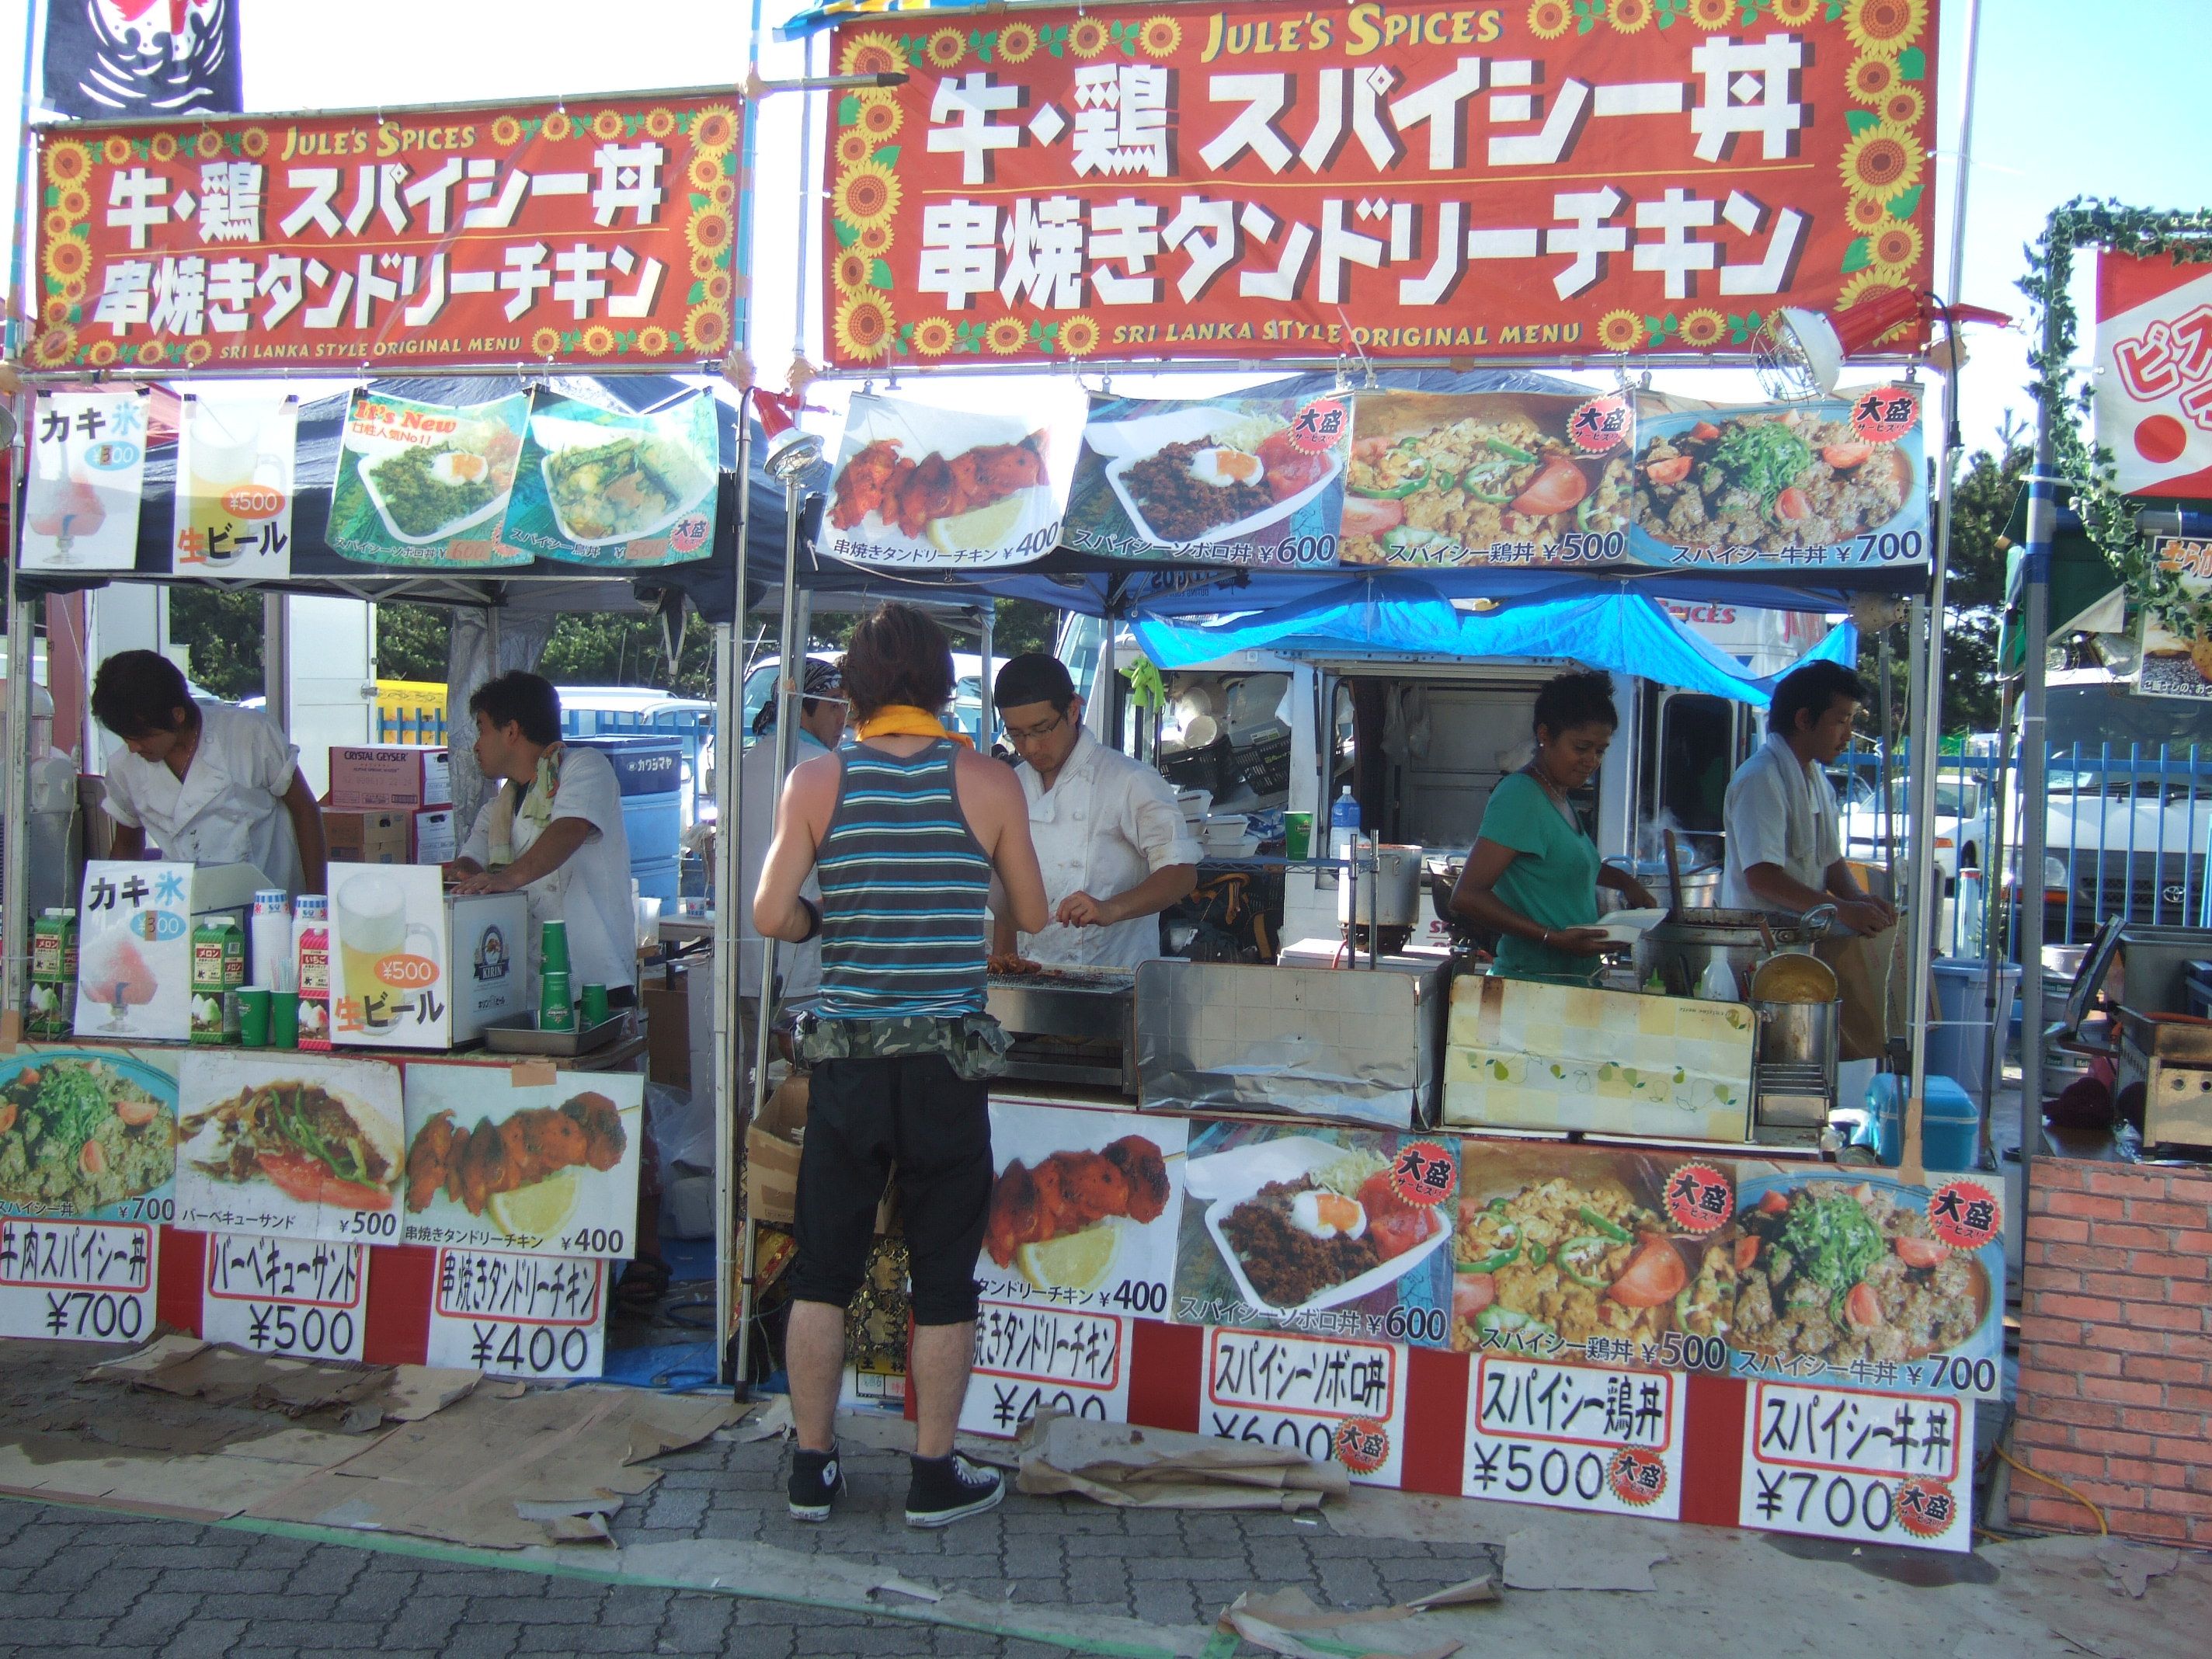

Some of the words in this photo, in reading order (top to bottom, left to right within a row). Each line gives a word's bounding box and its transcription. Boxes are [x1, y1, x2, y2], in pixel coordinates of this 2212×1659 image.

[1201, 12, 1333, 63] JULE'S
[1345, 2, 1504, 56] SPICES
[927, 64, 1167, 185] 牛・鶏
[1198, 33, 1803, 176] スパイシー丼
[282, 126, 368, 161] JULE'S
[377, 121, 478, 155] SPICES
[106, 160, 263, 249] 牛・鶏
[280, 141, 663, 239] スパイシー丼
[918, 186, 1804, 311] 串焼きタンドリーチキン
[94, 241, 665, 336] 串焼きタンドリーチキン
[220, 345, 252, 360] SRI
[254, 343, 311, 360] LANKA
[314, 343, 369, 358] STYLE
[372, 339, 464, 357] ORIGINAL
[468, 337, 522, 353] MENU
[1112, 325, 1157, 345] SRI
[1167, 322, 1253, 342] LANKA
[1263, 321, 1341, 345] STYLE
[1351, 325, 1487, 348] ORIGINAL
[1499, 322, 1582, 345] MENU
[40, 402, 142, 444] カキ氷
[354, 399, 396, 425] It's
[401, 410, 457, 434] New
[1296, 409, 1343, 433] 大盛
[1575, 408, 1626, 432] 大盛
[1856, 396, 1912, 423] 大盛
[230, 491, 279, 512] ¥500
[177, 521, 289, 564] 生ビール
[674, 520, 707, 538] 大盛
[833, 537, 998, 563] 串焼きタンドリーチキン
[1003, 521, 1060, 561] ¥400
[1074, 529, 1254, 563] スパイシーソボロ丼
[1257, 534, 1337, 564] ¥600
[1387, 541, 1536, 565] スパイシー鶏丼
[1542, 530, 1626, 563] ¥500
[1671, 543, 1828, 565] スパイシー牛丼
[1835, 530, 1923, 564] ¥700
[344, 750, 374, 762] CRYSTAL
[376, 752, 406, 762] GEYSER
[638, 756, 673, 772] カワシマヤ
[88, 870, 186, 912] カキ氷
[38, 938, 60, 949] メロン
[197, 949, 220, 958] メロン
[304, 955, 328, 965] いちご
[225, 962, 242, 972] メロン
[382, 960, 433, 982] ¥500
[482, 966, 503, 979] KIRIN
[334, 989, 445, 1033] 生ビール
[1397, 1150, 1452, 1189] 大盛
[119, 1197, 175, 1221] ¥700
[1671, 1174, 1727, 1214] 大盛
[1933, 1190, 1995, 1231] 大盛
[183, 1208, 296, 1229] バーベキューサンド
[339, 1212, 397, 1238] ¥500
[405, 1224, 544, 1249] 串焼きタンドリーチキン
[560, 1227, 624, 1255] ¥400
[0, 1221, 148, 1285] 牛肉スパイシー丼
[211, 1235, 360, 1303] バーベキューサンド
[442, 1250, 596, 1317] 串焼きタンドリーチキン
[1099, 1279, 1167, 1313] ¥400
[47, 1292, 143, 1338] ¥700
[250, 1304, 354, 1356] ¥500
[1177, 1296, 1361, 1335] スパイシーソボロ丼
[1366, 1305, 1447, 1342] ¥600
[471, 1323, 589, 1372] ¥400
[1480, 1324, 1632, 1361] スパイシー鶏丼
[1640, 1331, 1727, 1371] ¥500
[1216, 1339, 1386, 1413] スパイシーソボロ丼
[1737, 1348, 1897, 1386] スパイシー牛丼
[1905, 1354, 1996, 1393] ¥700
[1482, 1370, 1663, 1445] スパイシー鶏丼
[1340, 1425, 1385, 1457] 大盛
[1762, 1397, 1949, 1472] スパイシー牛丼
[1473, 1441, 1604, 1501] ¥500
[1615, 1455, 1661, 1489] 大盛
[1755, 1467, 1894, 1532] ¥700
[1900, 1486, 1949, 1521] 大盛
